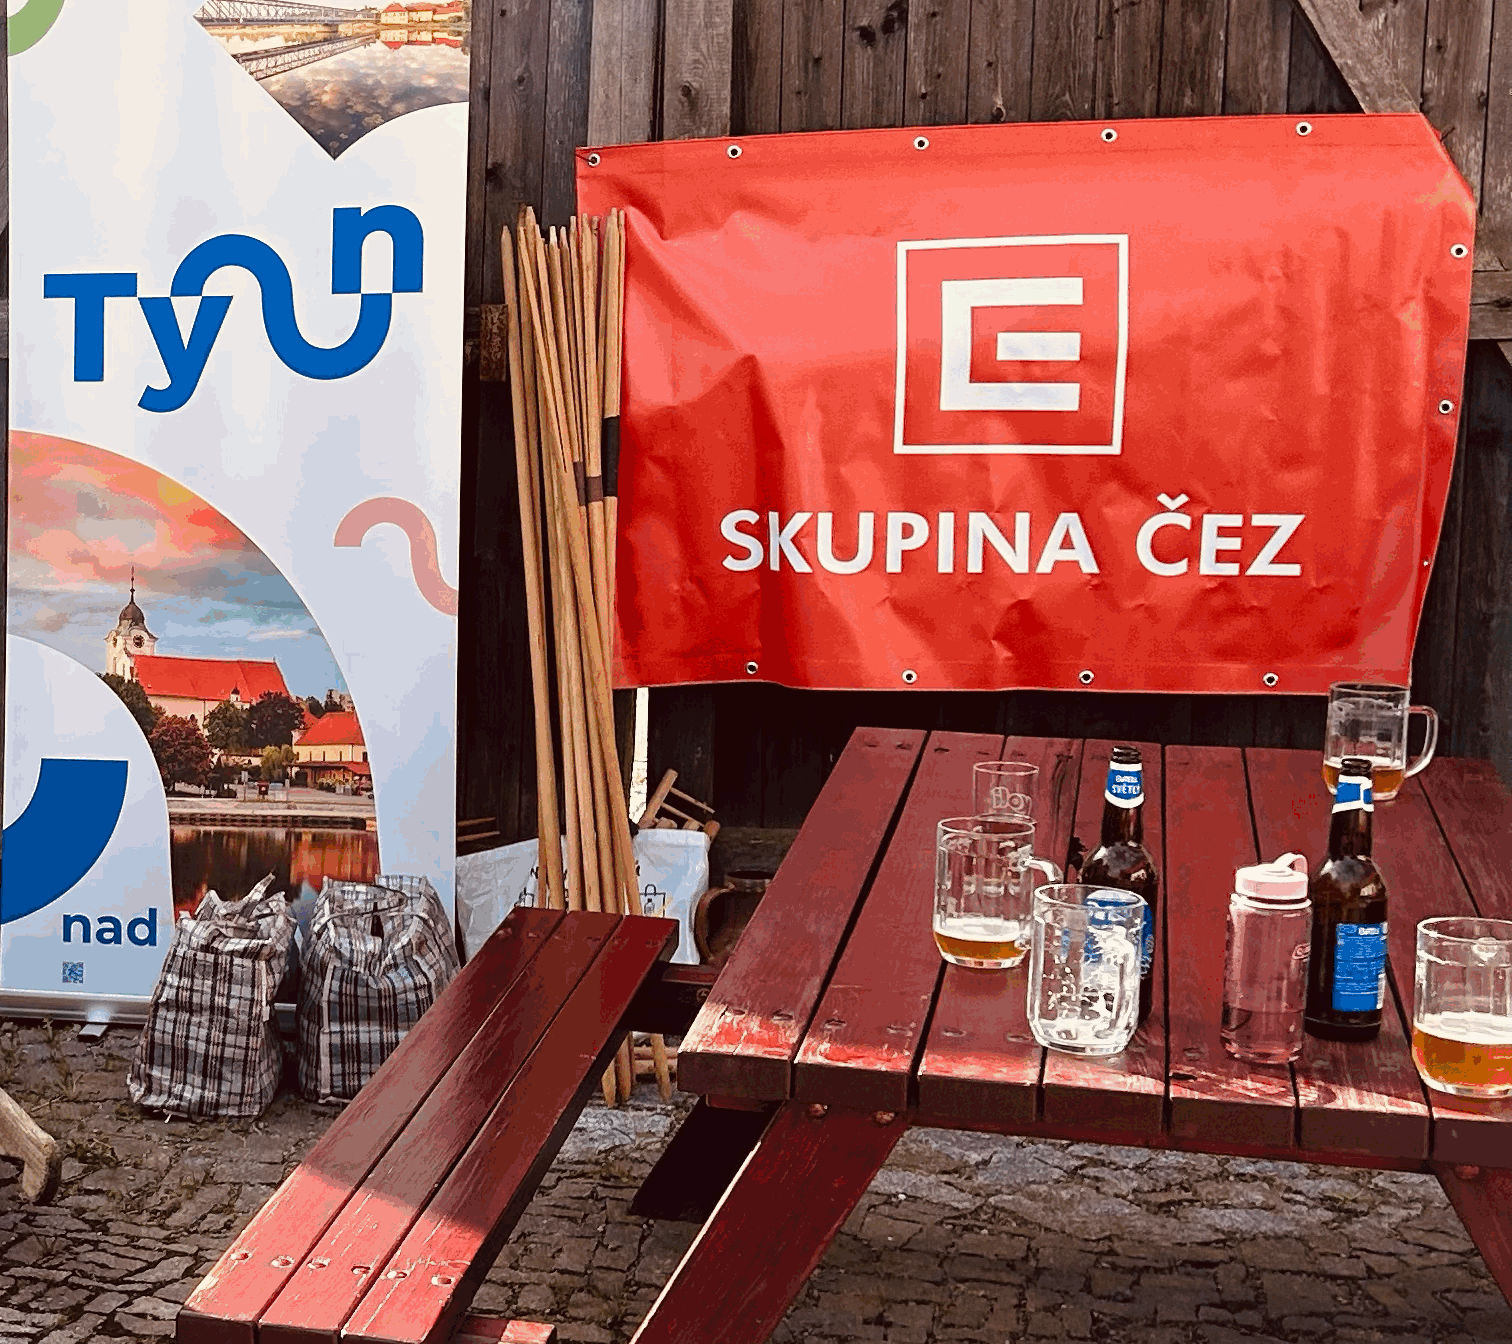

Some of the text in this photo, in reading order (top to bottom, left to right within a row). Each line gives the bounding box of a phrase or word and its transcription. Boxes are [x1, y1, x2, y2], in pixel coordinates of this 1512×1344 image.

[719, 493, 1306, 577] SKUPINA ČEZ
[62, 907, 158, 947] nad
